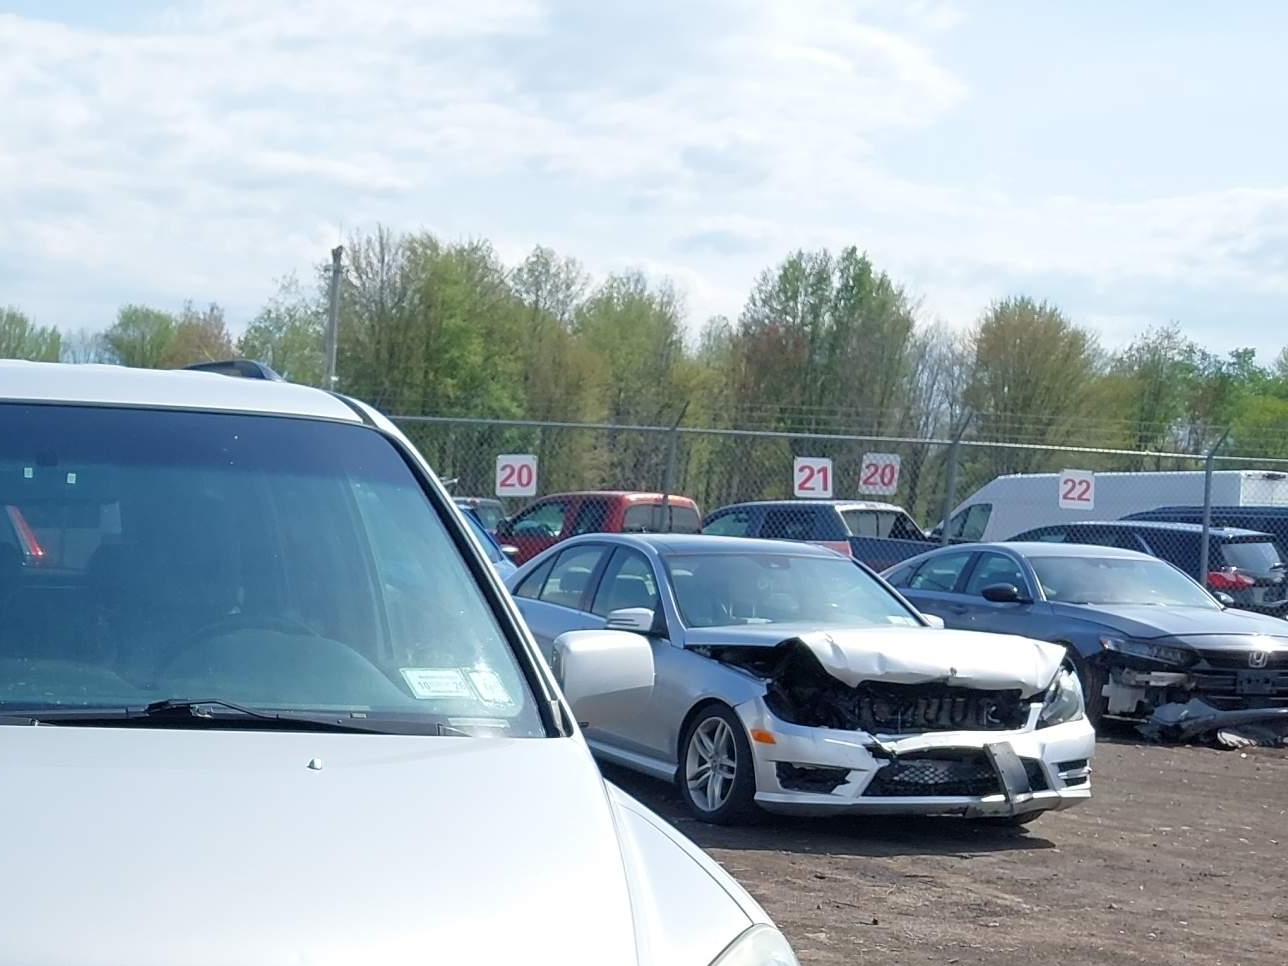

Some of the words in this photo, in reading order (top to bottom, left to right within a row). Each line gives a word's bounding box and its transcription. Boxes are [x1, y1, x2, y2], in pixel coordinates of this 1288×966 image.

[499, 463, 533, 488] 20
[798, 464, 828, 491] 21
[862, 463, 895, 487] 20
[1062, 478, 1091, 502] 22
